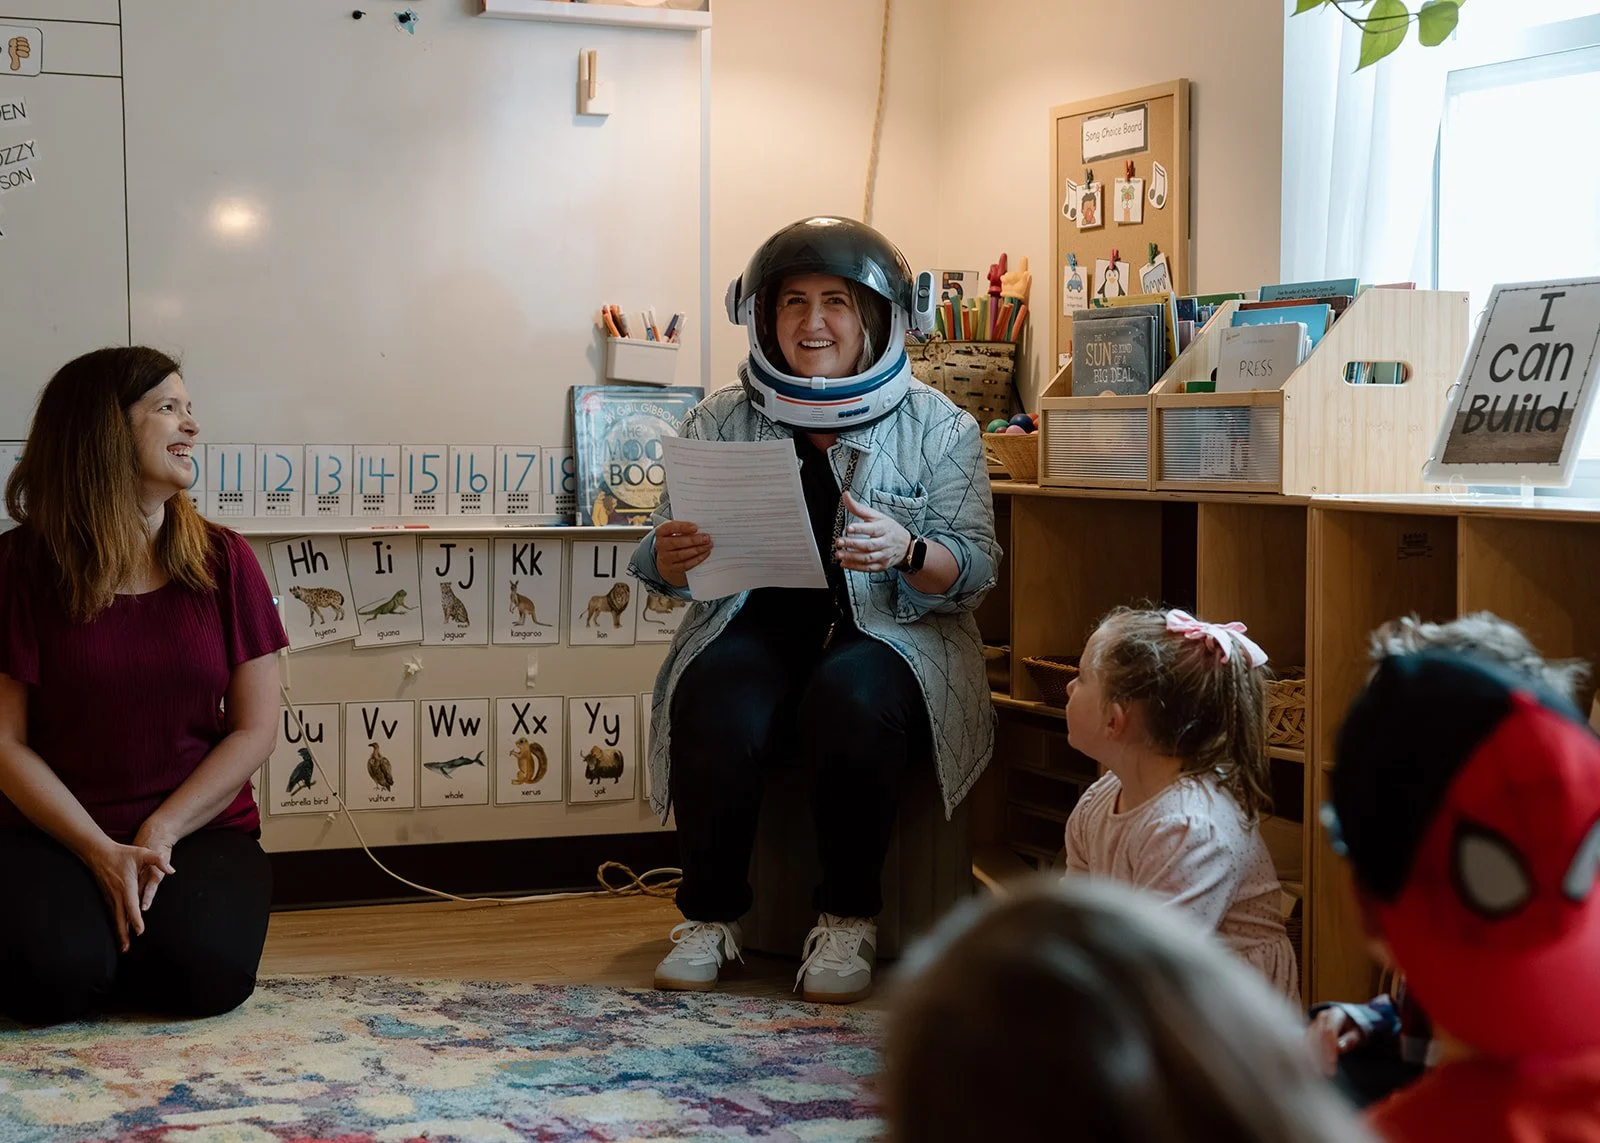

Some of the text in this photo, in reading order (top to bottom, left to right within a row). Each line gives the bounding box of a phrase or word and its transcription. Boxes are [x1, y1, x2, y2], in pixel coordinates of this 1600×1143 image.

[0, 101, 26, 121] EN
[1085, 120, 1142, 143] Song Choice Board
[0, 141, 35, 167] ZZY
[1529, 291, 1566, 333] I
[1085, 342, 1112, 367] SUN
[1094, 367, 1134, 384] BIG DEAL
[1239, 358, 1273, 379] PRESS
[616, 402, 639, 416] GAIL
[641, 403, 683, 428] GIBBONS
[604, 439, 663, 462] MOO
[221, 452, 241, 492] 11
[264, 453, 294, 492] 12
[315, 454, 342, 495] 13
[360, 456, 395, 495] 14
[409, 453, 440, 495] 15
[456, 453, 488, 494] 16
[504, 453, 537, 492] 17
[610, 464, 666, 486] BOO
[288, 540, 329, 577] Hh
[371, 541, 393, 575] Ii
[435, 543, 475, 590] Jj
[512, 543, 543, 577] Kk
[594, 545, 617, 578] Ll
[314, 627, 337, 640] hyena
[377, 629, 400, 641] iguana
[441, 630, 467, 642] jaguar
[510, 629, 543, 640] kangaroo
[596, 630, 608, 639] lion
[285, 710, 324, 744] Uu
[361, 708, 398, 740] Vv
[429, 705, 481, 738] Ww
[512, 703, 547, 736] Xx
[585, 703, 620, 747] Yy
[280, 796, 329, 808] umbrella bird
[368, 794, 396, 803] vulture
[444, 790, 464, 800] whale
[520, 788, 542, 796] xerus
[594, 786, 606, 798] yak
